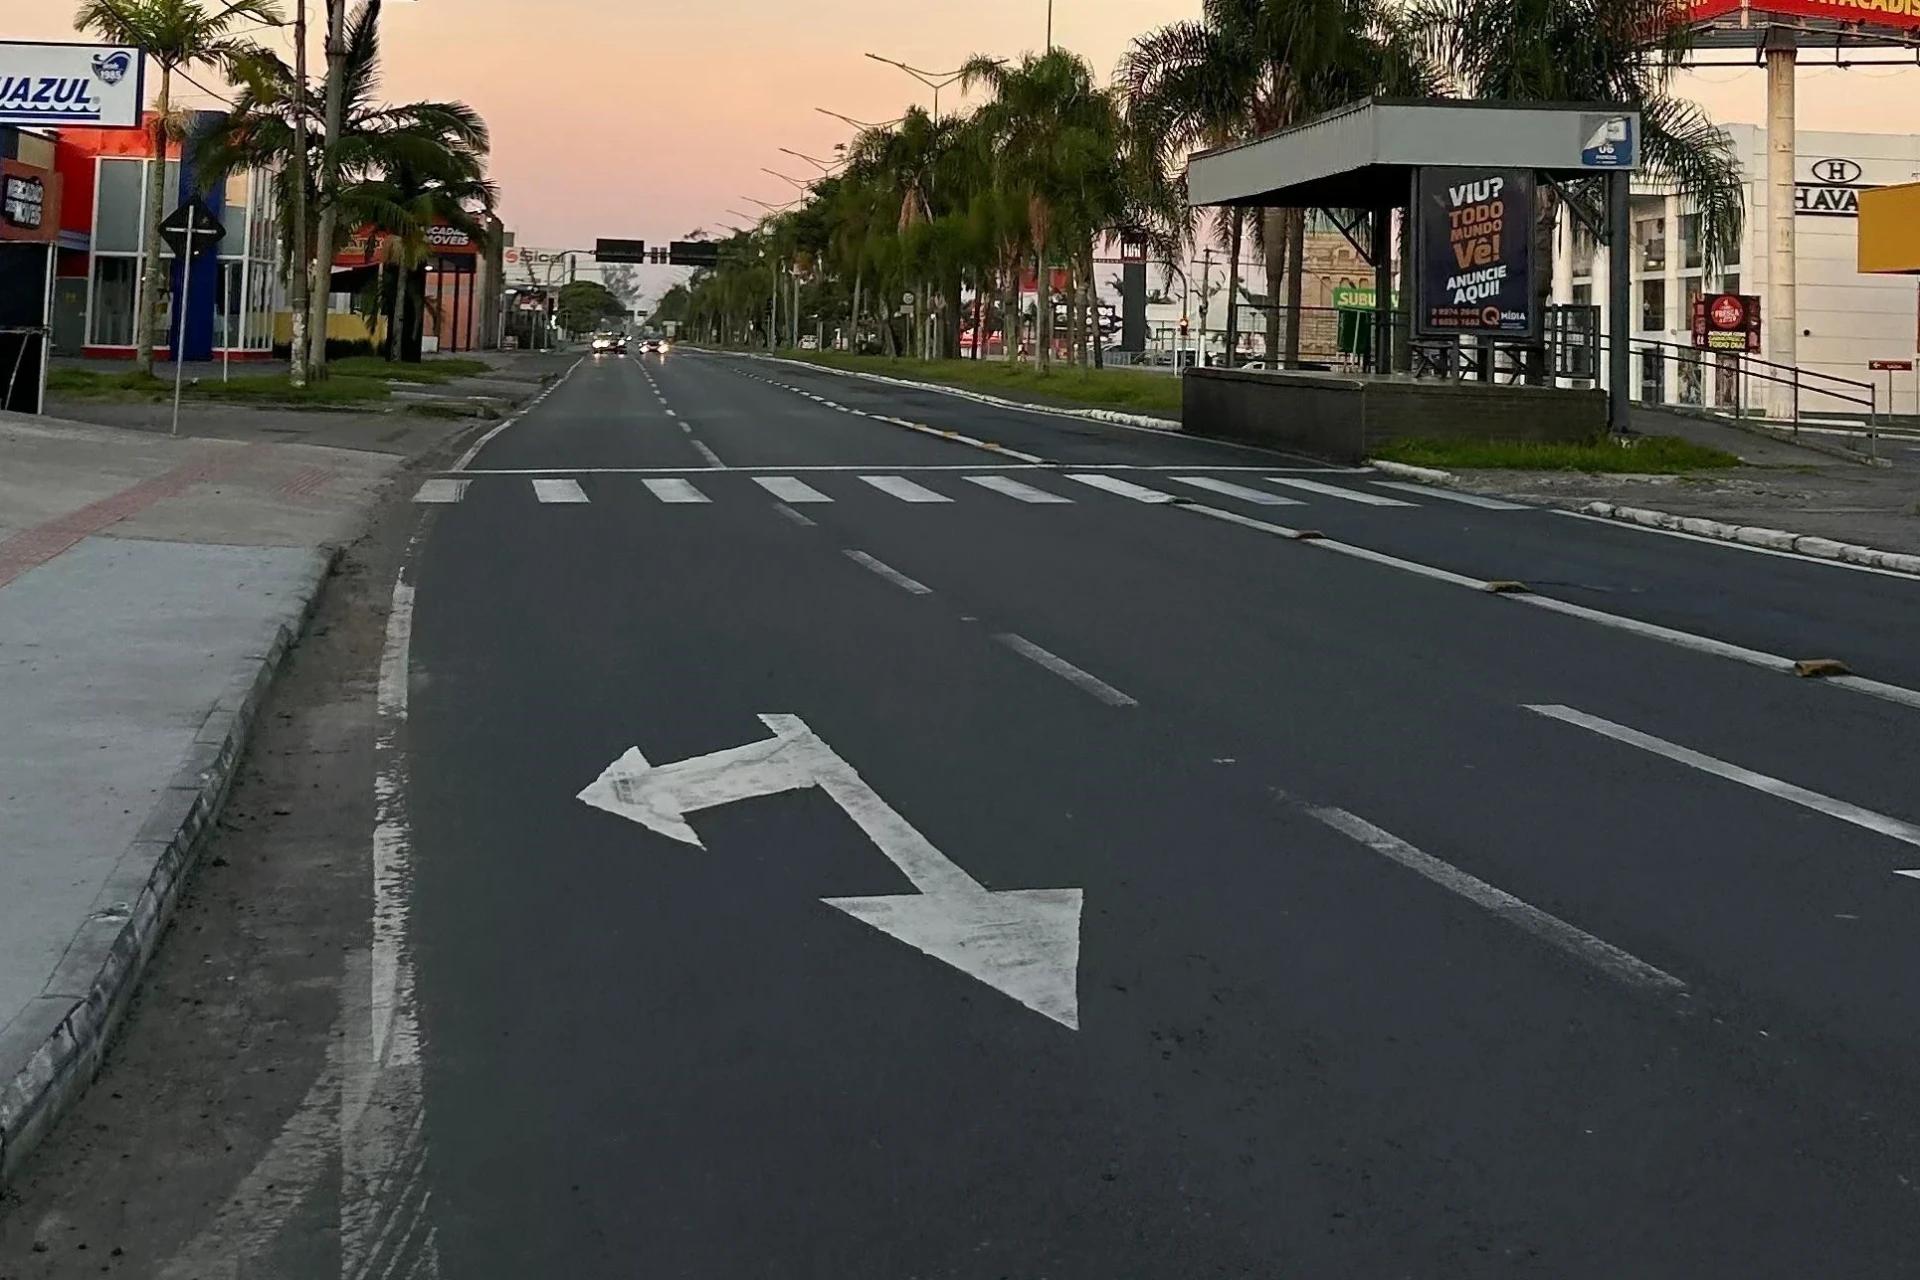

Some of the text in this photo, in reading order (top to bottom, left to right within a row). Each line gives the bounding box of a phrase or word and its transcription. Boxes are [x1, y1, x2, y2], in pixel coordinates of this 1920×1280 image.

[1828, 163, 1846, 179] H
[1449, 177, 1504, 207] VIU?
[1449, 201, 1504, 228] TODO
[1450, 220, 1502, 242] MUNDO
[1453, 234, 1500, 269] Vê!
[1446, 265, 1507, 290] ANUNCIE
[1454, 280, 1500, 304] AQUI!
[1501, 310, 1525, 321] MÍDIA
